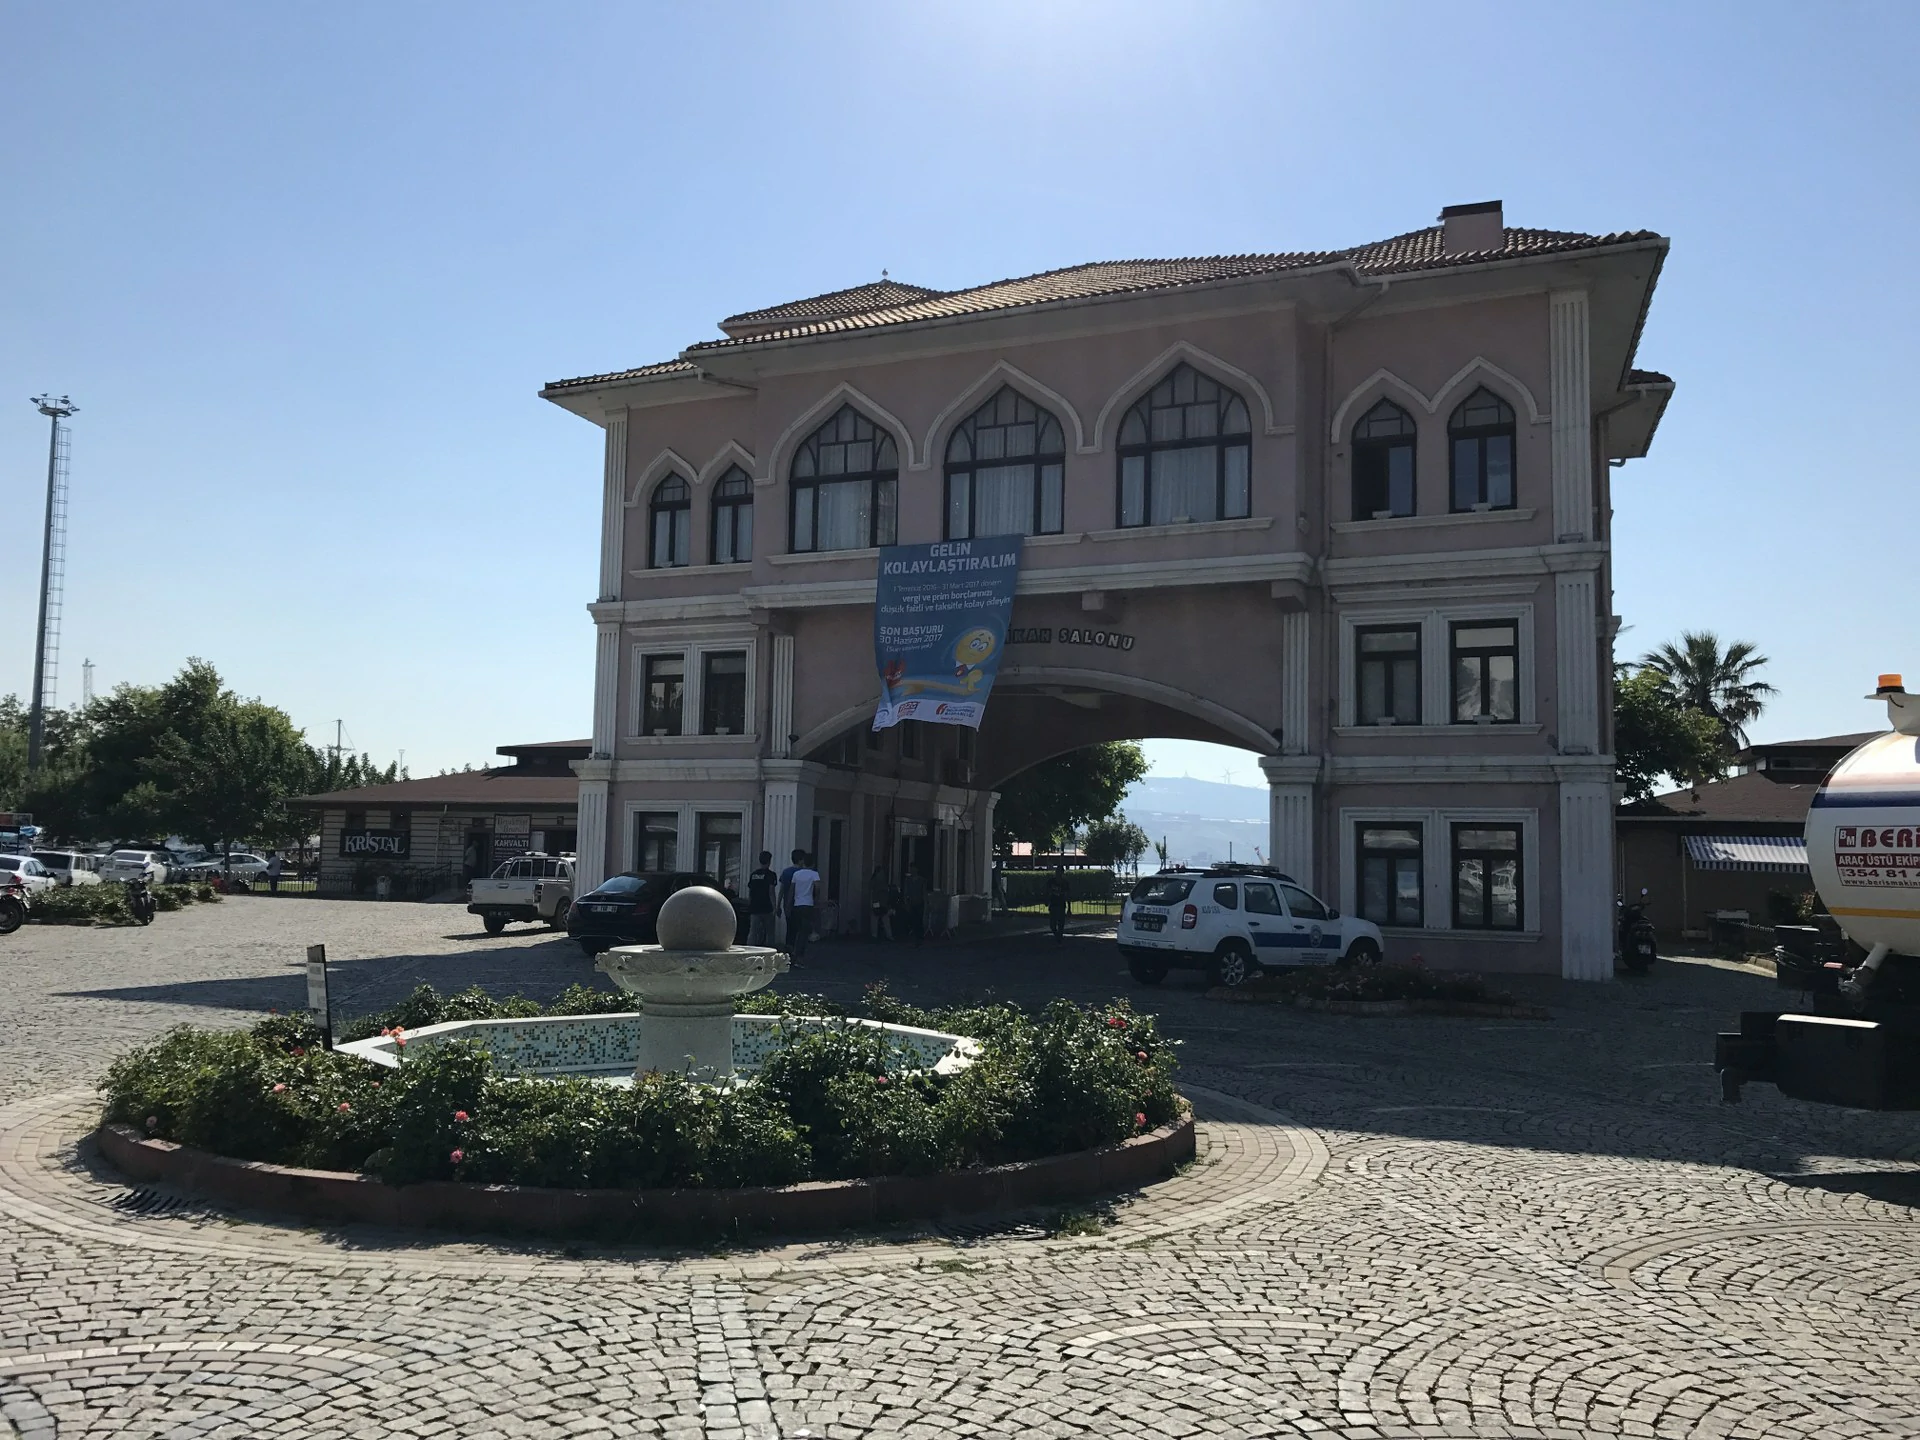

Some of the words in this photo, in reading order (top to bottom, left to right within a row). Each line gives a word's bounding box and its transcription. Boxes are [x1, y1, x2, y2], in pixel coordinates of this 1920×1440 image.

[930, 542, 971, 557] GELİN
[883, 553, 1016, 575] KOLAYLAŞTIRALIM
[902, 594, 921, 605] vergi
[922, 594, 932, 602] ve
[932, 593, 950, 603] prim
[925, 604, 934, 612] ve
[964, 599, 985, 610] kolay
[880, 626, 901, 635] SON
[902, 625, 944, 637] BAŞVURU
[879, 635, 892, 645] 30
[893, 636, 922, 645] Haziran
[923, 634, 943, 643] 2017
[1004, 625, 1052, 645] İKAH
[1058, 628, 1135, 651] SALONU
[344, 831, 405, 854] KRİSTAL
[494, 840, 529, 848] KAHVALTI
[1861, 828, 1920, 848] BERİ
[1839, 855, 1864, 867] ARAÇ
[1867, 854, 1893, 866] ÜSTÜ
[1896, 854, 1920, 866] EKİP
[1845, 869, 1880, 877] 354
[1886, 869, 1908, 878] 81
